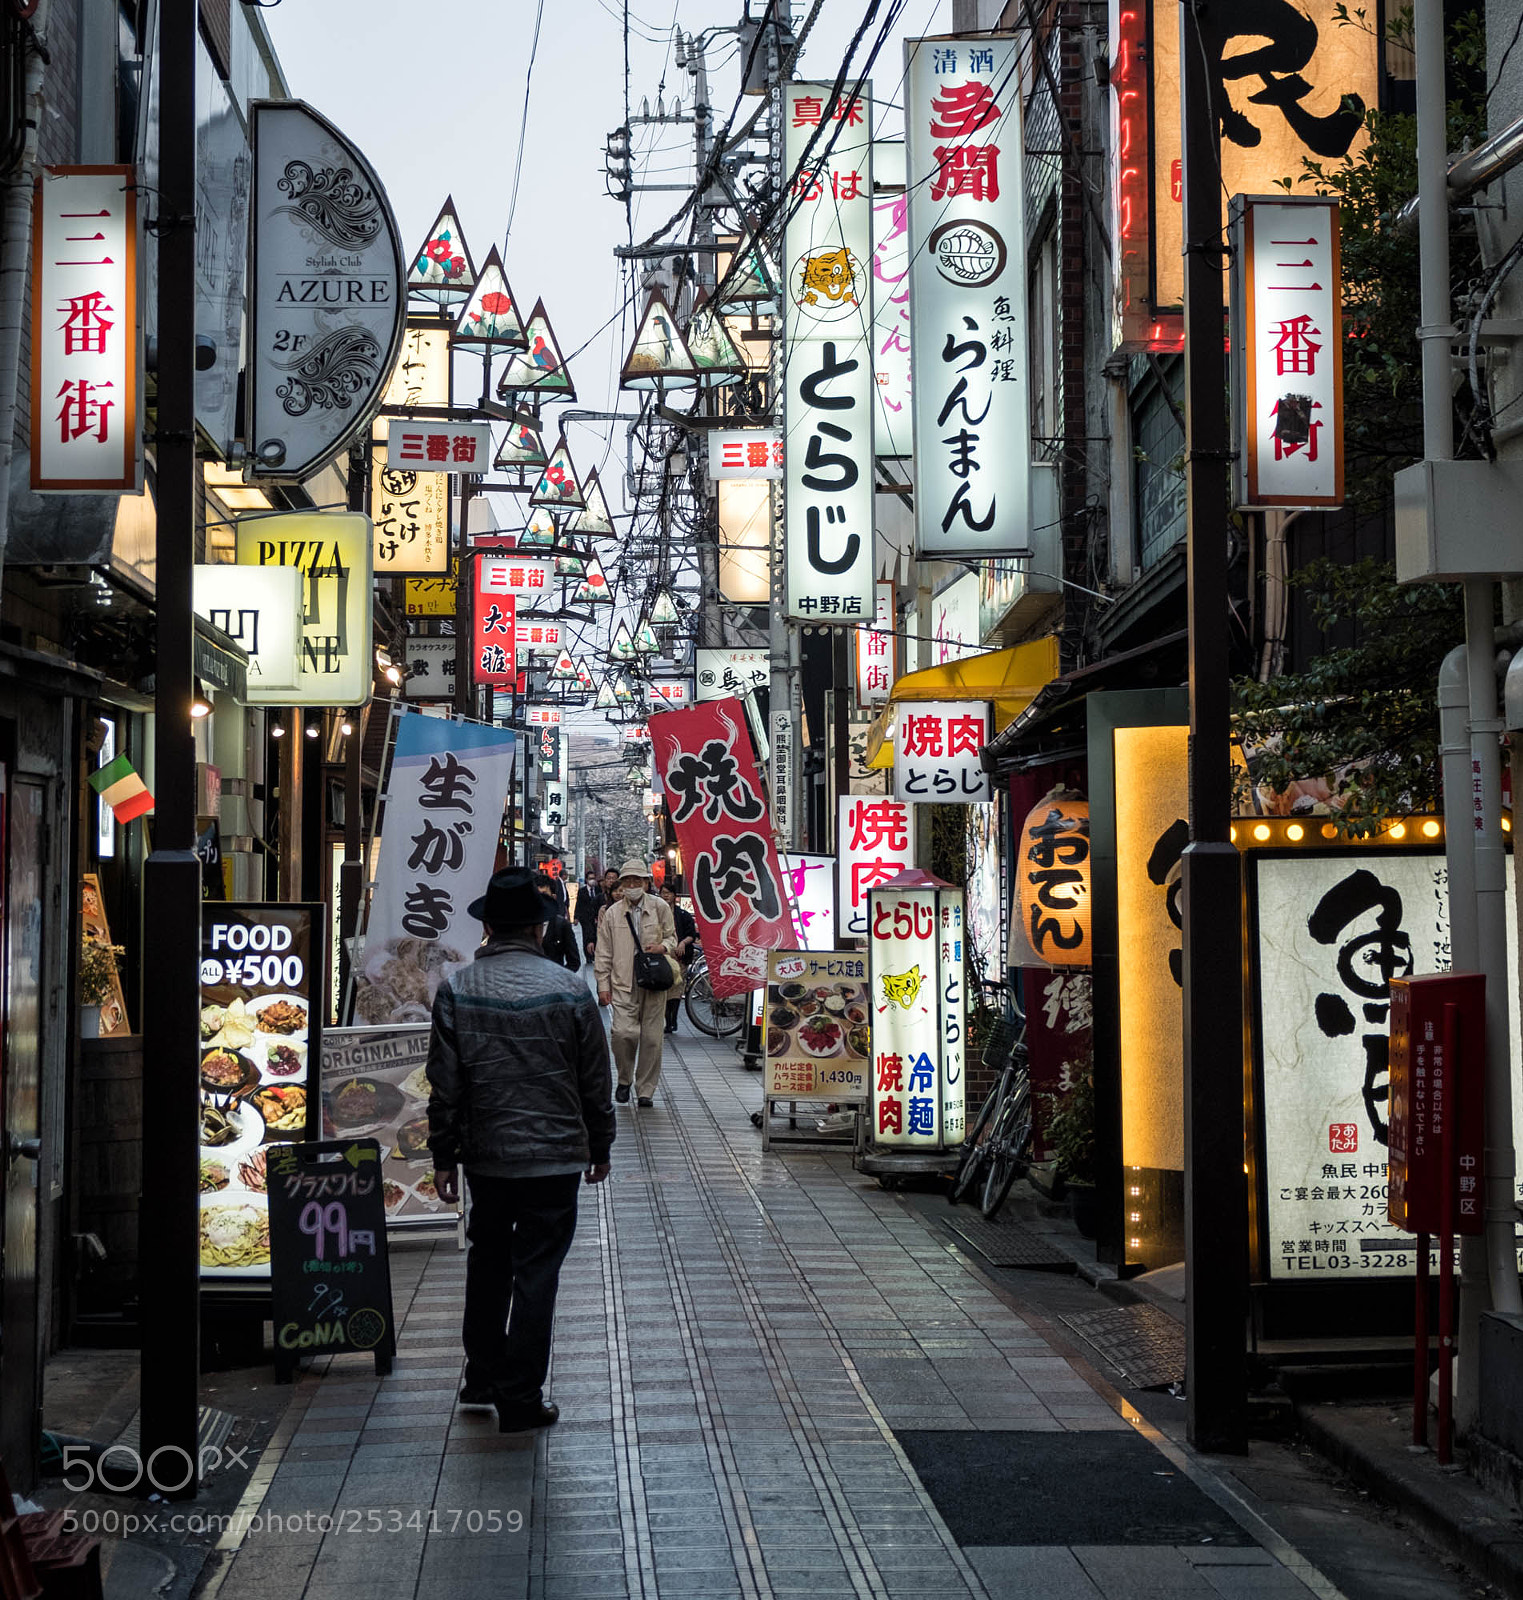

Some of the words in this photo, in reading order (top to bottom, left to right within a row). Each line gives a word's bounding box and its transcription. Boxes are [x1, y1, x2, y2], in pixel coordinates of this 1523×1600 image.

[933, 48, 994, 74] 清酒
[305, 255, 337, 269] Stylish
[338, 255, 363, 268] Club
[276, 279, 391, 303] AZURE
[54, 209, 115, 443] 三番街
[989, 295, 1018, 383] 魚料理
[272, 329, 306, 353] 2F
[937, 315, 996, 534] らんまん
[400, 433, 477, 463] 三番街
[799, 341, 861, 575] とらじ
[257, 541, 347, 578] PIZZA
[490, 567, 545, 588] 三番街
[408, 603, 423, 614] B1
[798, 595, 862, 615] 中野店
[516, 627, 560, 643] 三番街
[650, 686, 683, 698] 三番街
[530, 711, 561, 722] 三番街
[902, 714, 985, 758] 焼肉
[904, 768, 985, 795] とらじ
[667, 738, 784, 924] 焼肉
[401, 750, 479, 941] 生がき
[848, 799, 909, 908] 焼肉
[1027, 808, 1090, 954] おでん
[873, 901, 933, 940] とらじ
[212, 924, 293, 951] FOOD
[201, 965, 220, 978] ALL
[225, 955, 304, 986] ¥500
[779, 961, 804, 975] 大人気
[809, 959, 865, 977] サービス定食
[945, 973, 961, 1086] とらじ
[1424, 1021, 1435, 1041] 注意
[321, 1042, 403, 1070] ORIGINAL
[774, 1063, 813, 1071] カルビ定食
[774, 1072, 813, 1081] ハラミ定食
[774, 1082, 813, 1091] ロース定食
[819, 1070, 862, 1084] 1,430円
[1433, 1045, 1443, 1134] 非常の場合以外は
[877, 1052, 903, 1135] 焼肉
[1415, 1045, 1426, 1156] 手を触れないで下さい
[1321, 1163, 1357, 1178] 魚民
[284, 1173, 375, 1198] グラスワイン
[1459, 1154, 1476, 1215] 中野区
[300, 1201, 375, 1260] 99円
[1281, 1240, 1347, 1254] 営業時間
